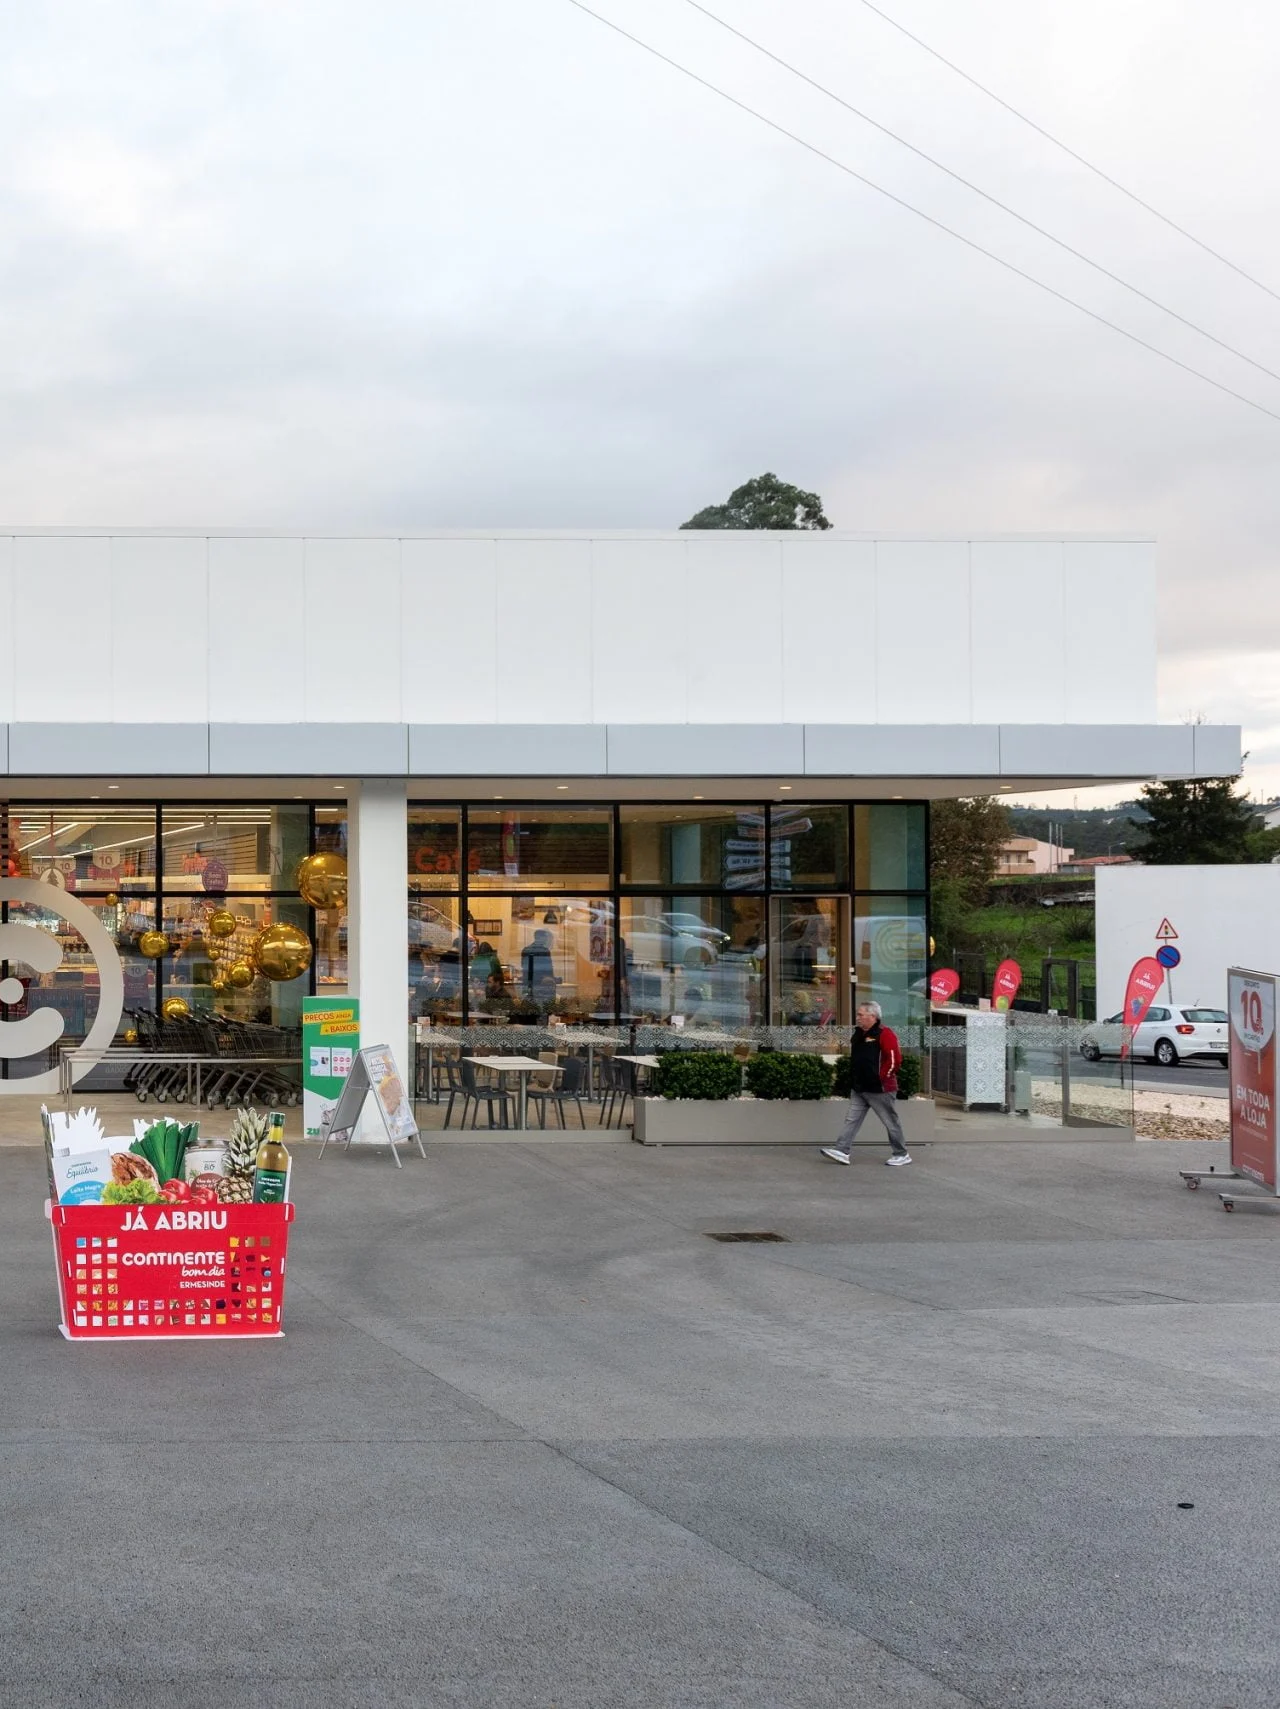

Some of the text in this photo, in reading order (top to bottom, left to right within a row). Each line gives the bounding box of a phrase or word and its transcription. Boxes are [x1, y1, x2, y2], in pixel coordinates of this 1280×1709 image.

[1247, 1088, 1270, 1111] TODA
[1246, 1107, 1267, 1129] LOJA
[120, 1206, 227, 1231] JÁ ABRIU
[122, 1251, 225, 1266] CONTINENTE
[179, 1280, 226, 1289] ERMESINDE
